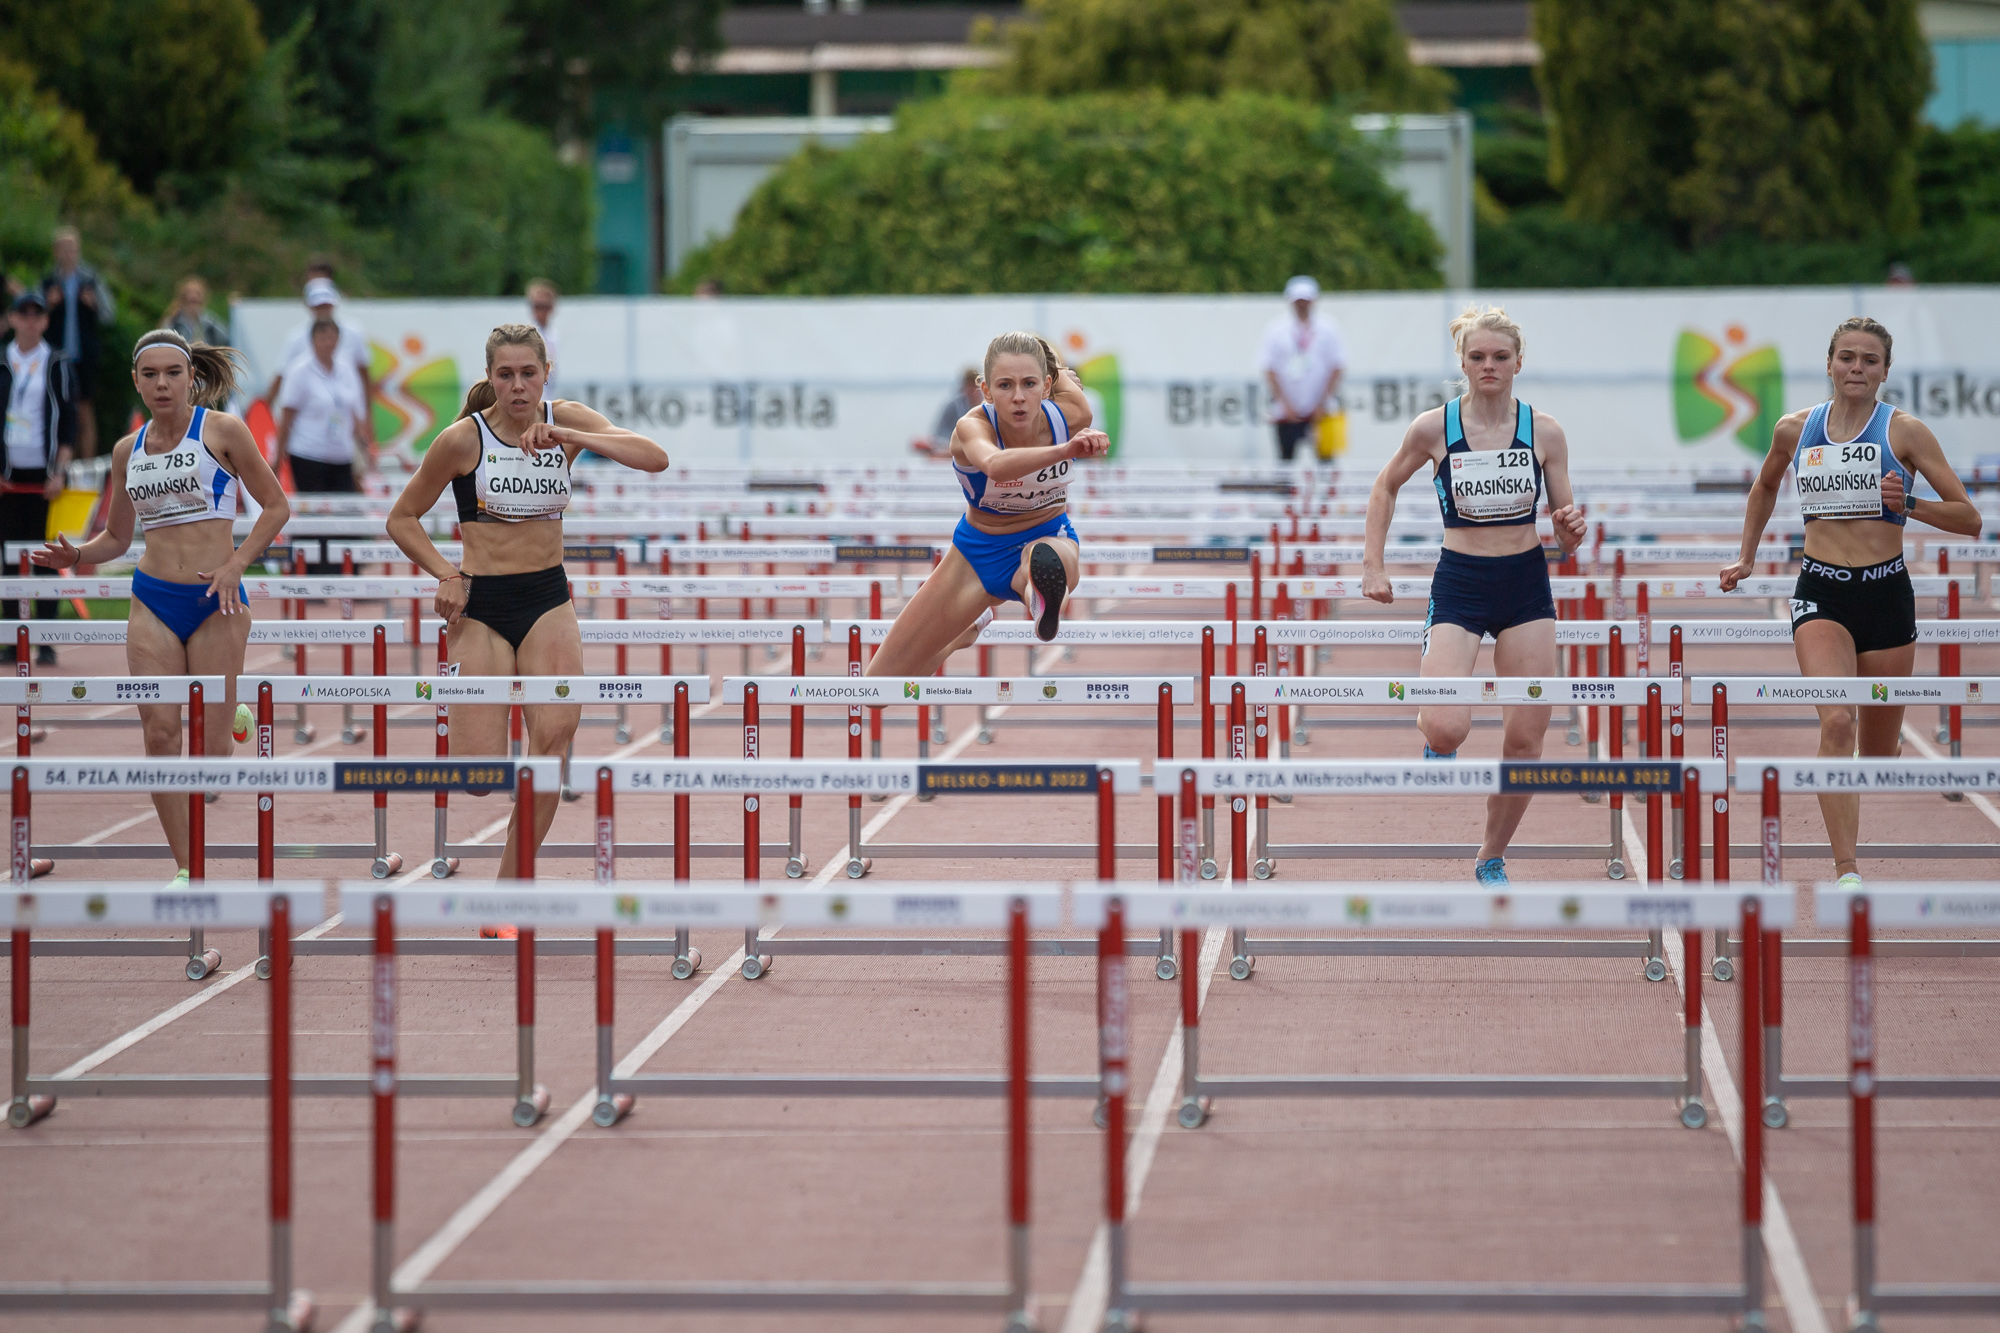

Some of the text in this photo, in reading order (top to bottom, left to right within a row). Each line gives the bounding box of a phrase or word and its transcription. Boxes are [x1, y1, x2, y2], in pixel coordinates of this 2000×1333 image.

[531, 452, 564, 469] 329
[1496, 452, 1530, 468] 128
[1841, 446, 1877, 463] 540
[164, 452, 196, 470] 783
[1036, 460, 1069, 483] 610
[489, 477, 568, 496] GADAJSKA
[1454, 476, 1534, 497] KRASIŃSKA
[1800, 470, 1878, 494] SKOLASIŃSKA
[128, 476, 201, 501] DOMAŃSKA
[1808, 562, 1853, 582] PRO
[1861, 557, 1904, 582] NIKE
[1794, 600, 1811, 613] 4
[40, 632, 73, 641] XXVIII
[283, 629, 318, 640] lekkiej
[321, 628, 366, 640] atletyce
[581, 630, 629, 641] limpiada
[632, 629, 689, 641] Młodzieży
[701, 628, 735, 640] lekkiej
[738, 628, 783, 640] atletyce
[1110, 629, 1146, 640] lekkiej
[1149, 629, 1194, 640] atletyce
[1276, 630, 1307, 638] XXVIII
[1310, 629, 1385, 640] Ogólnopolska
[1555, 628, 1600, 640] atletyce
[1691, 627, 1793, 639] XXVIII Ogólnopolsk
[1936, 627, 1970, 639] lekkiej
[116, 683, 160, 691] BBOSiR
[316, 687, 392, 697] MAŁOPOLSKA
[437, 687, 485, 696] Bielsko-Biała
[598, 683, 643, 691] BBOSiR
[805, 687, 880, 697] MAŁOPOLSKA
[925, 687, 973, 696] Bielsko-Biała
[1086, 683, 1129, 692] BBOSiR
[1290, 688, 1364, 698] MAŁOPOLSKA
[1410, 687, 1457, 696] Bielsko-Biała
[1571, 683, 1615, 691] BBOSiR
[1772, 688, 1848, 698] MAŁOPOLSKA
[1894, 689, 1942, 697] Bielsko-Biała
[45, 769, 506, 786] 54. PZLA Mistrzostwa Polski U18 BIELSKO-BIAŁA 2022
[630, 772, 1089, 788] 54. PZLA Mistrzostwa Polski U18 BIELSKO-BIAŁA 2022
[1213, 769, 1672, 788] 54. PZLA Mistrzostwa Polski U18 BIELSKO-BIAŁA 2022
[1793, 772, 1820, 787] 54.
[1827, 772, 1868, 787] PZLA
[1875, 770, 1980, 787] Mistrzostwa
